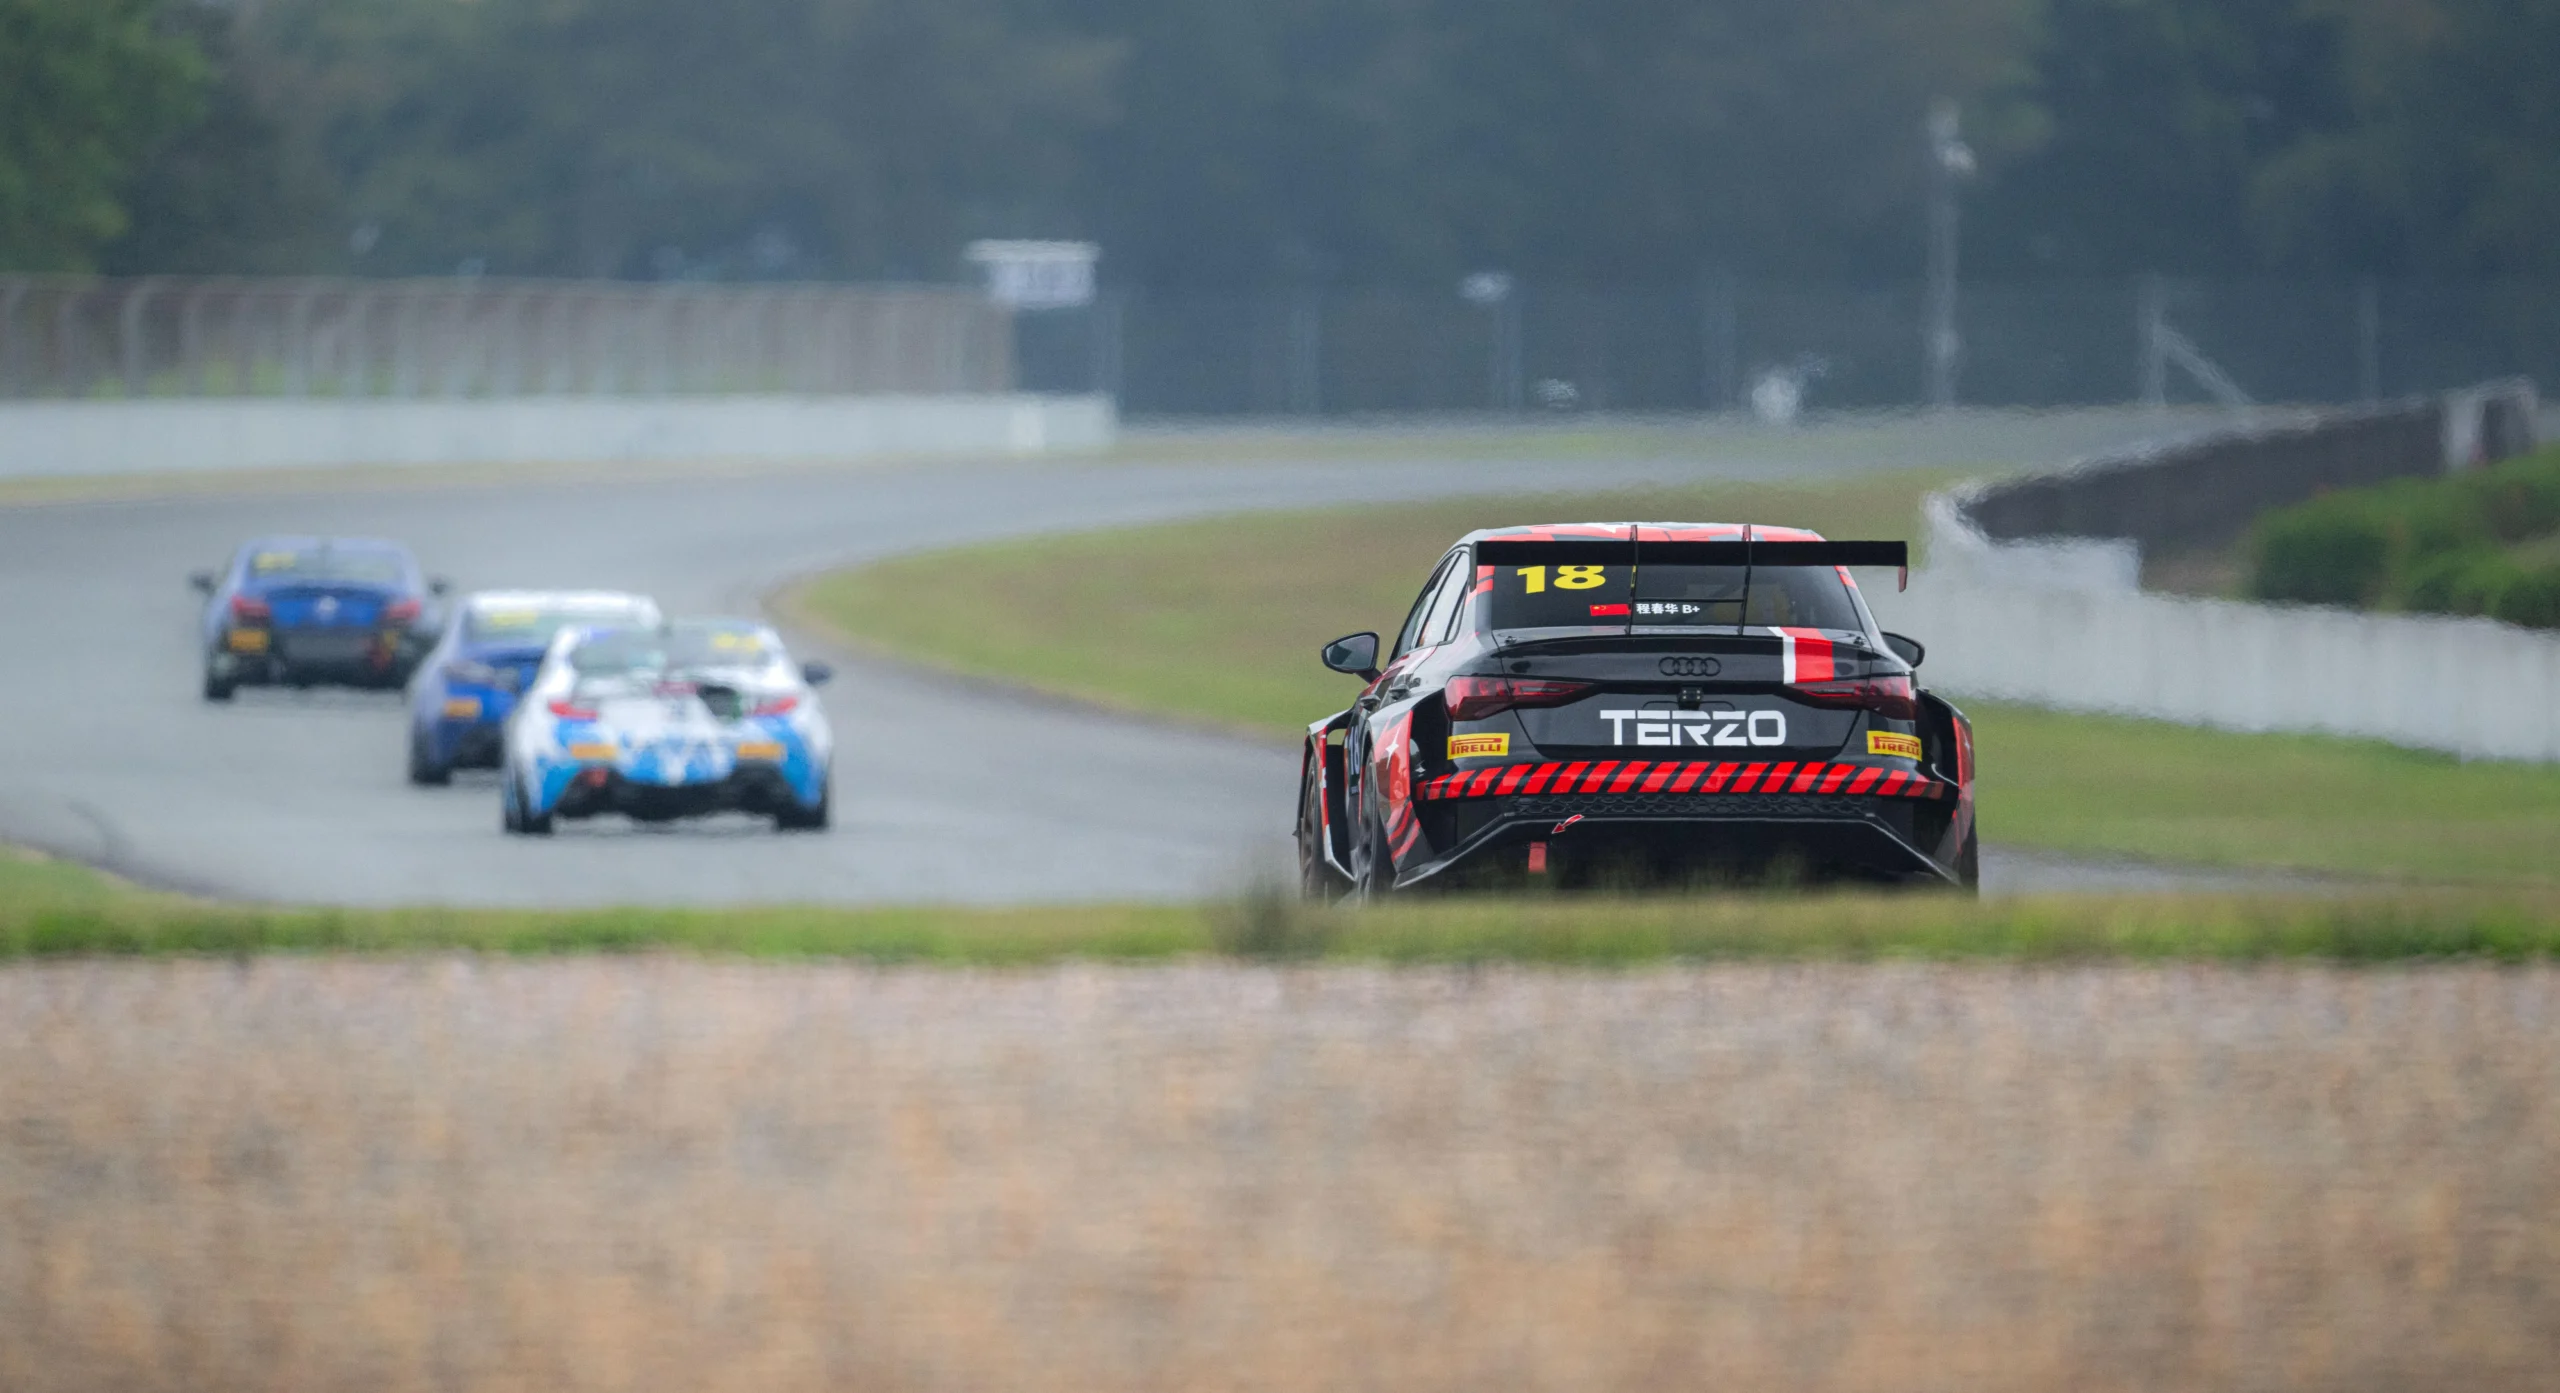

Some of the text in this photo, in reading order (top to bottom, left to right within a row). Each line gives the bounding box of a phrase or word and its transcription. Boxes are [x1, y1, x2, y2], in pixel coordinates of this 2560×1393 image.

[1517, 565, 1606, 594] 18
[1636, 603, 1700, 614] 程春华 B+
[1600, 710, 1786, 746] TERZO
[1451, 738, 1502, 755] PIRELLI
[1873, 736, 1919, 756] PIRELLI
